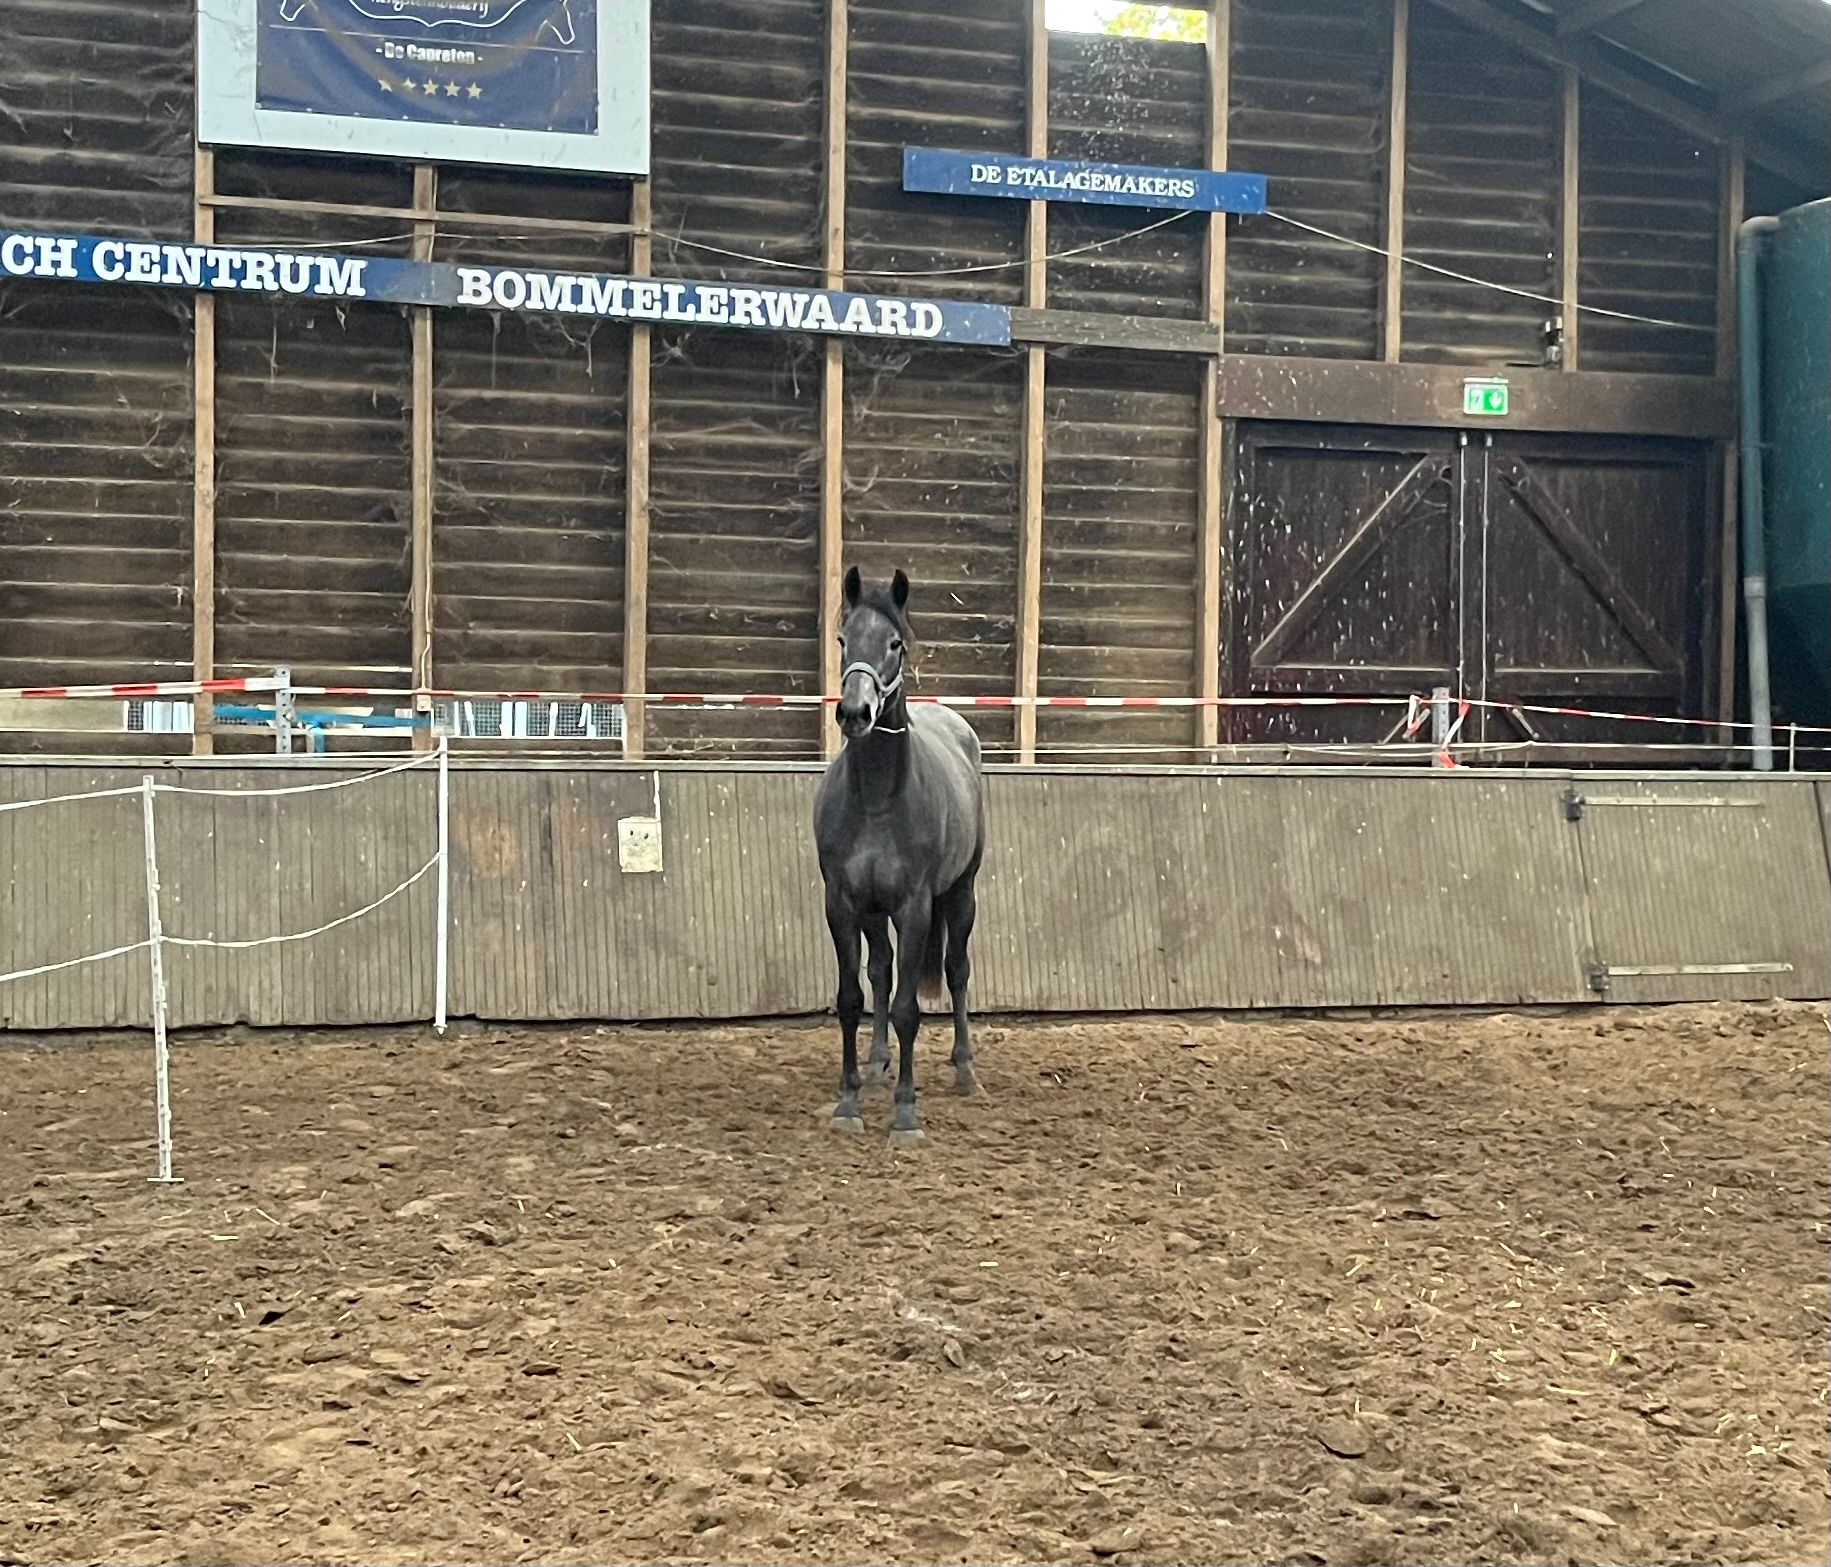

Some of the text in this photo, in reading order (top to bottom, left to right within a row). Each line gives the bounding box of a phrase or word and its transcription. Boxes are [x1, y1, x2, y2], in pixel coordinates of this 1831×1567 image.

[971, 164, 1196, 199] DE ETALAGEMAKERS
[1, 234, 944, 339] CH CENTRUM BOMMELERWAARD
